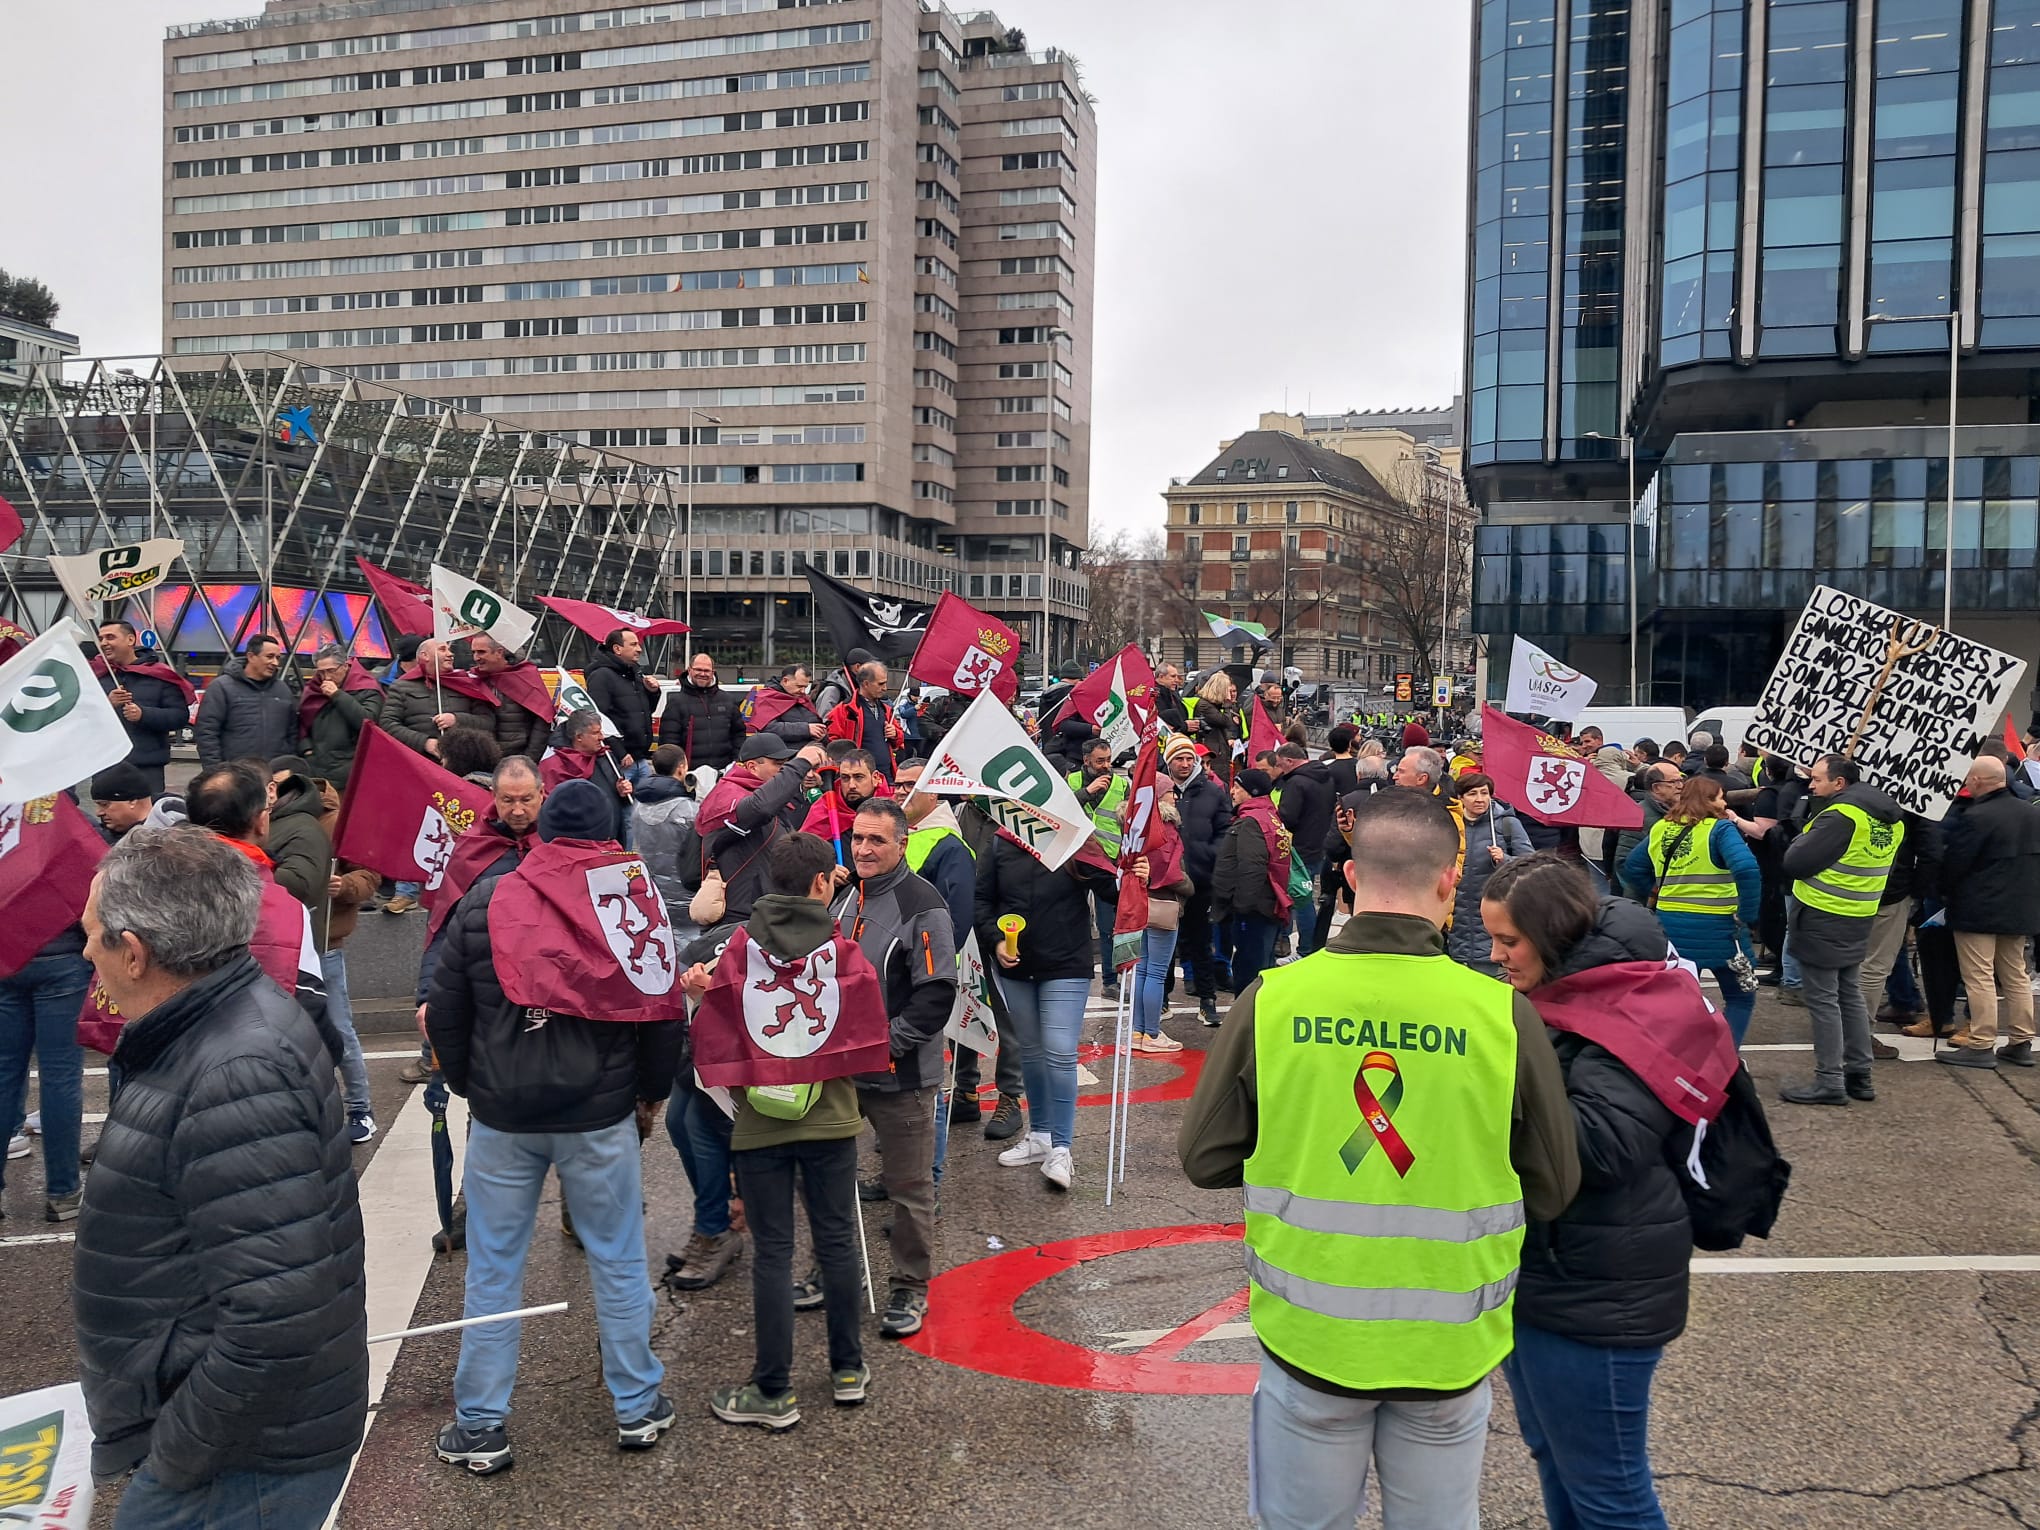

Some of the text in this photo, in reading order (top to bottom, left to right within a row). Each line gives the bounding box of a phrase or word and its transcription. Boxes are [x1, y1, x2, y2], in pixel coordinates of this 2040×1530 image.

[1231, 457, 1270, 473] PSN
[1801, 612, 1891, 665] GANADEROS
[1966, 675, 2000, 705] EN
[1809, 587, 1861, 621] LOS
[1993, 657, 2017, 678] Y
[1765, 677, 1950, 770] EL AÑO 2024 POR
[1790, 634, 1977, 724] EL AÑO 2020 AHORA
[1822, 673, 1954, 744] DELINCUENTES
[1950, 728, 1987, 759] EN
[1745, 723, 1933, 814] CONDICI DIGNAS
[1755, 700, 1963, 801] SALIR A RECLAMAR UNAS
[1293, 1016, 1467, 1056] DECALEON
